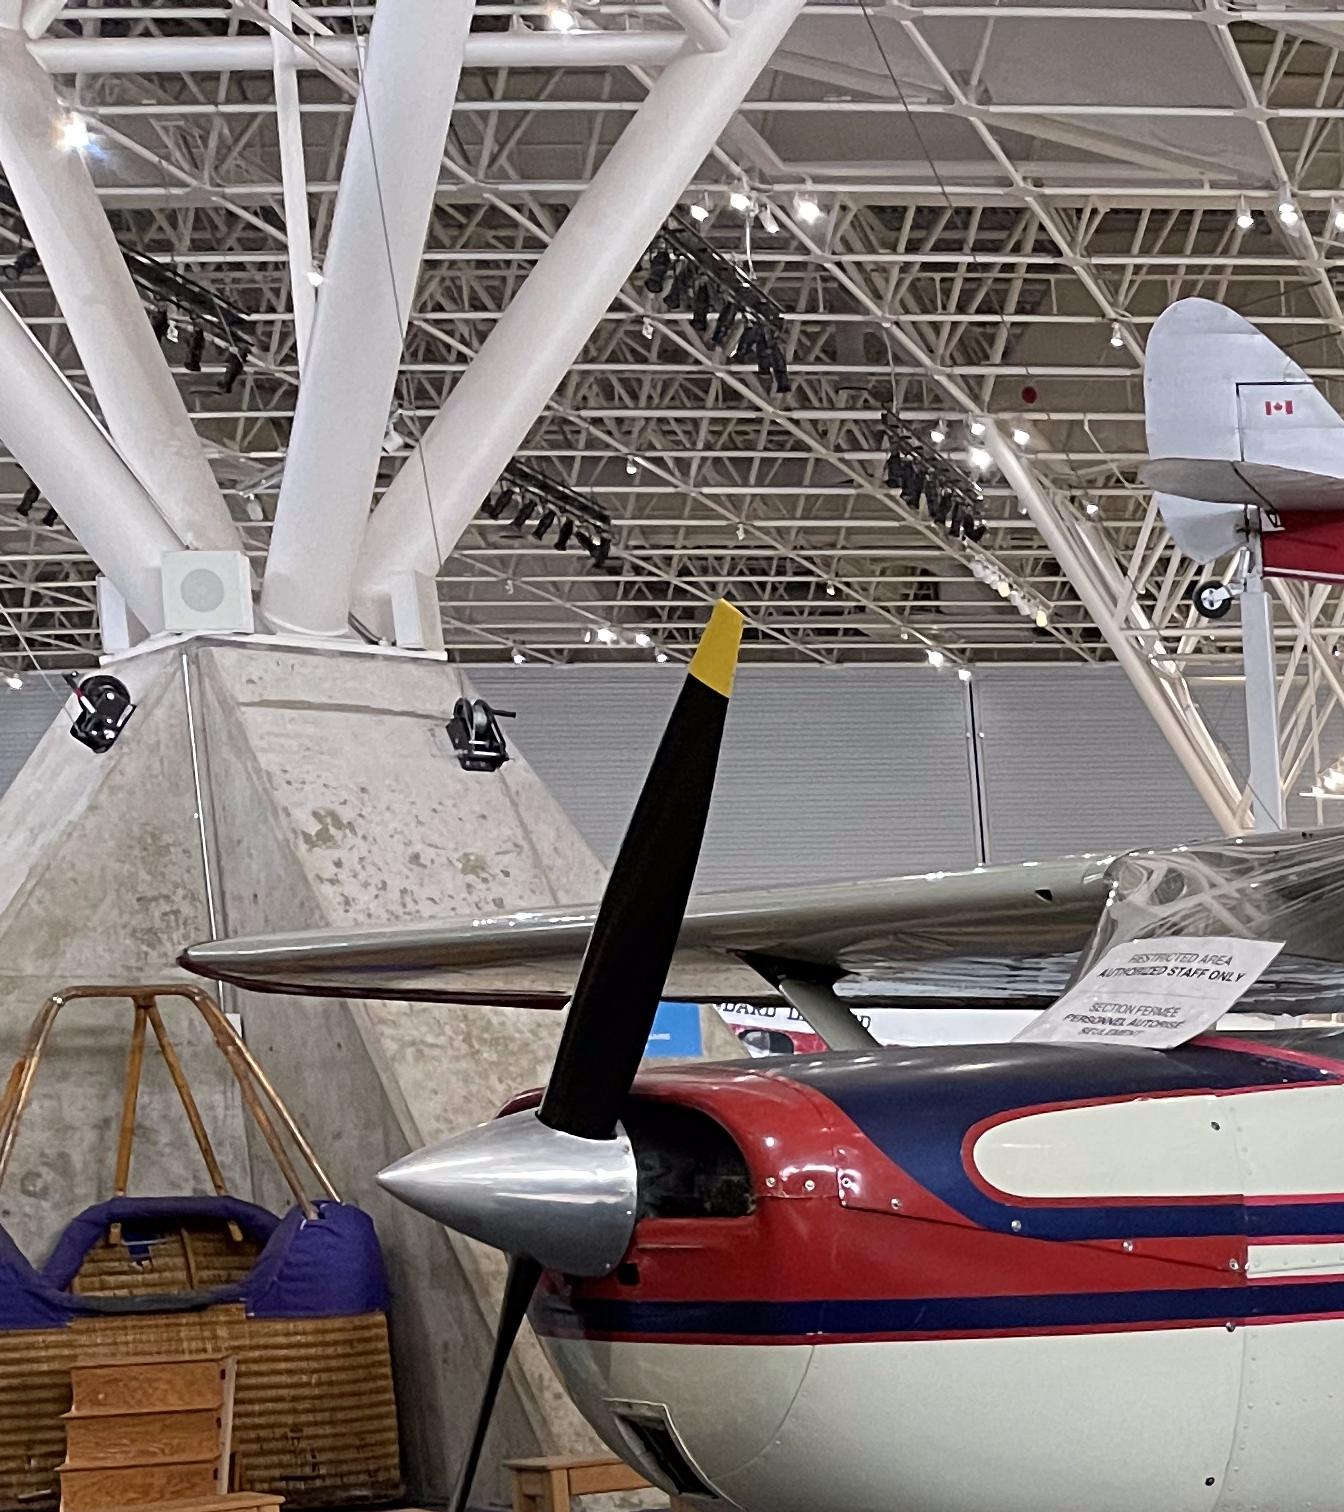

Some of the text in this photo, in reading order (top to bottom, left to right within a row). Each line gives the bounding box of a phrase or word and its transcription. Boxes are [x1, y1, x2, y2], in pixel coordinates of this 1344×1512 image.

[1128, 952, 1233, 967] RESTRICTED AREA
[1097, 965, 1247, 983] AUTHORIZED STAFF ONLY
[1089, 1002, 1136, 1015] SECTION
